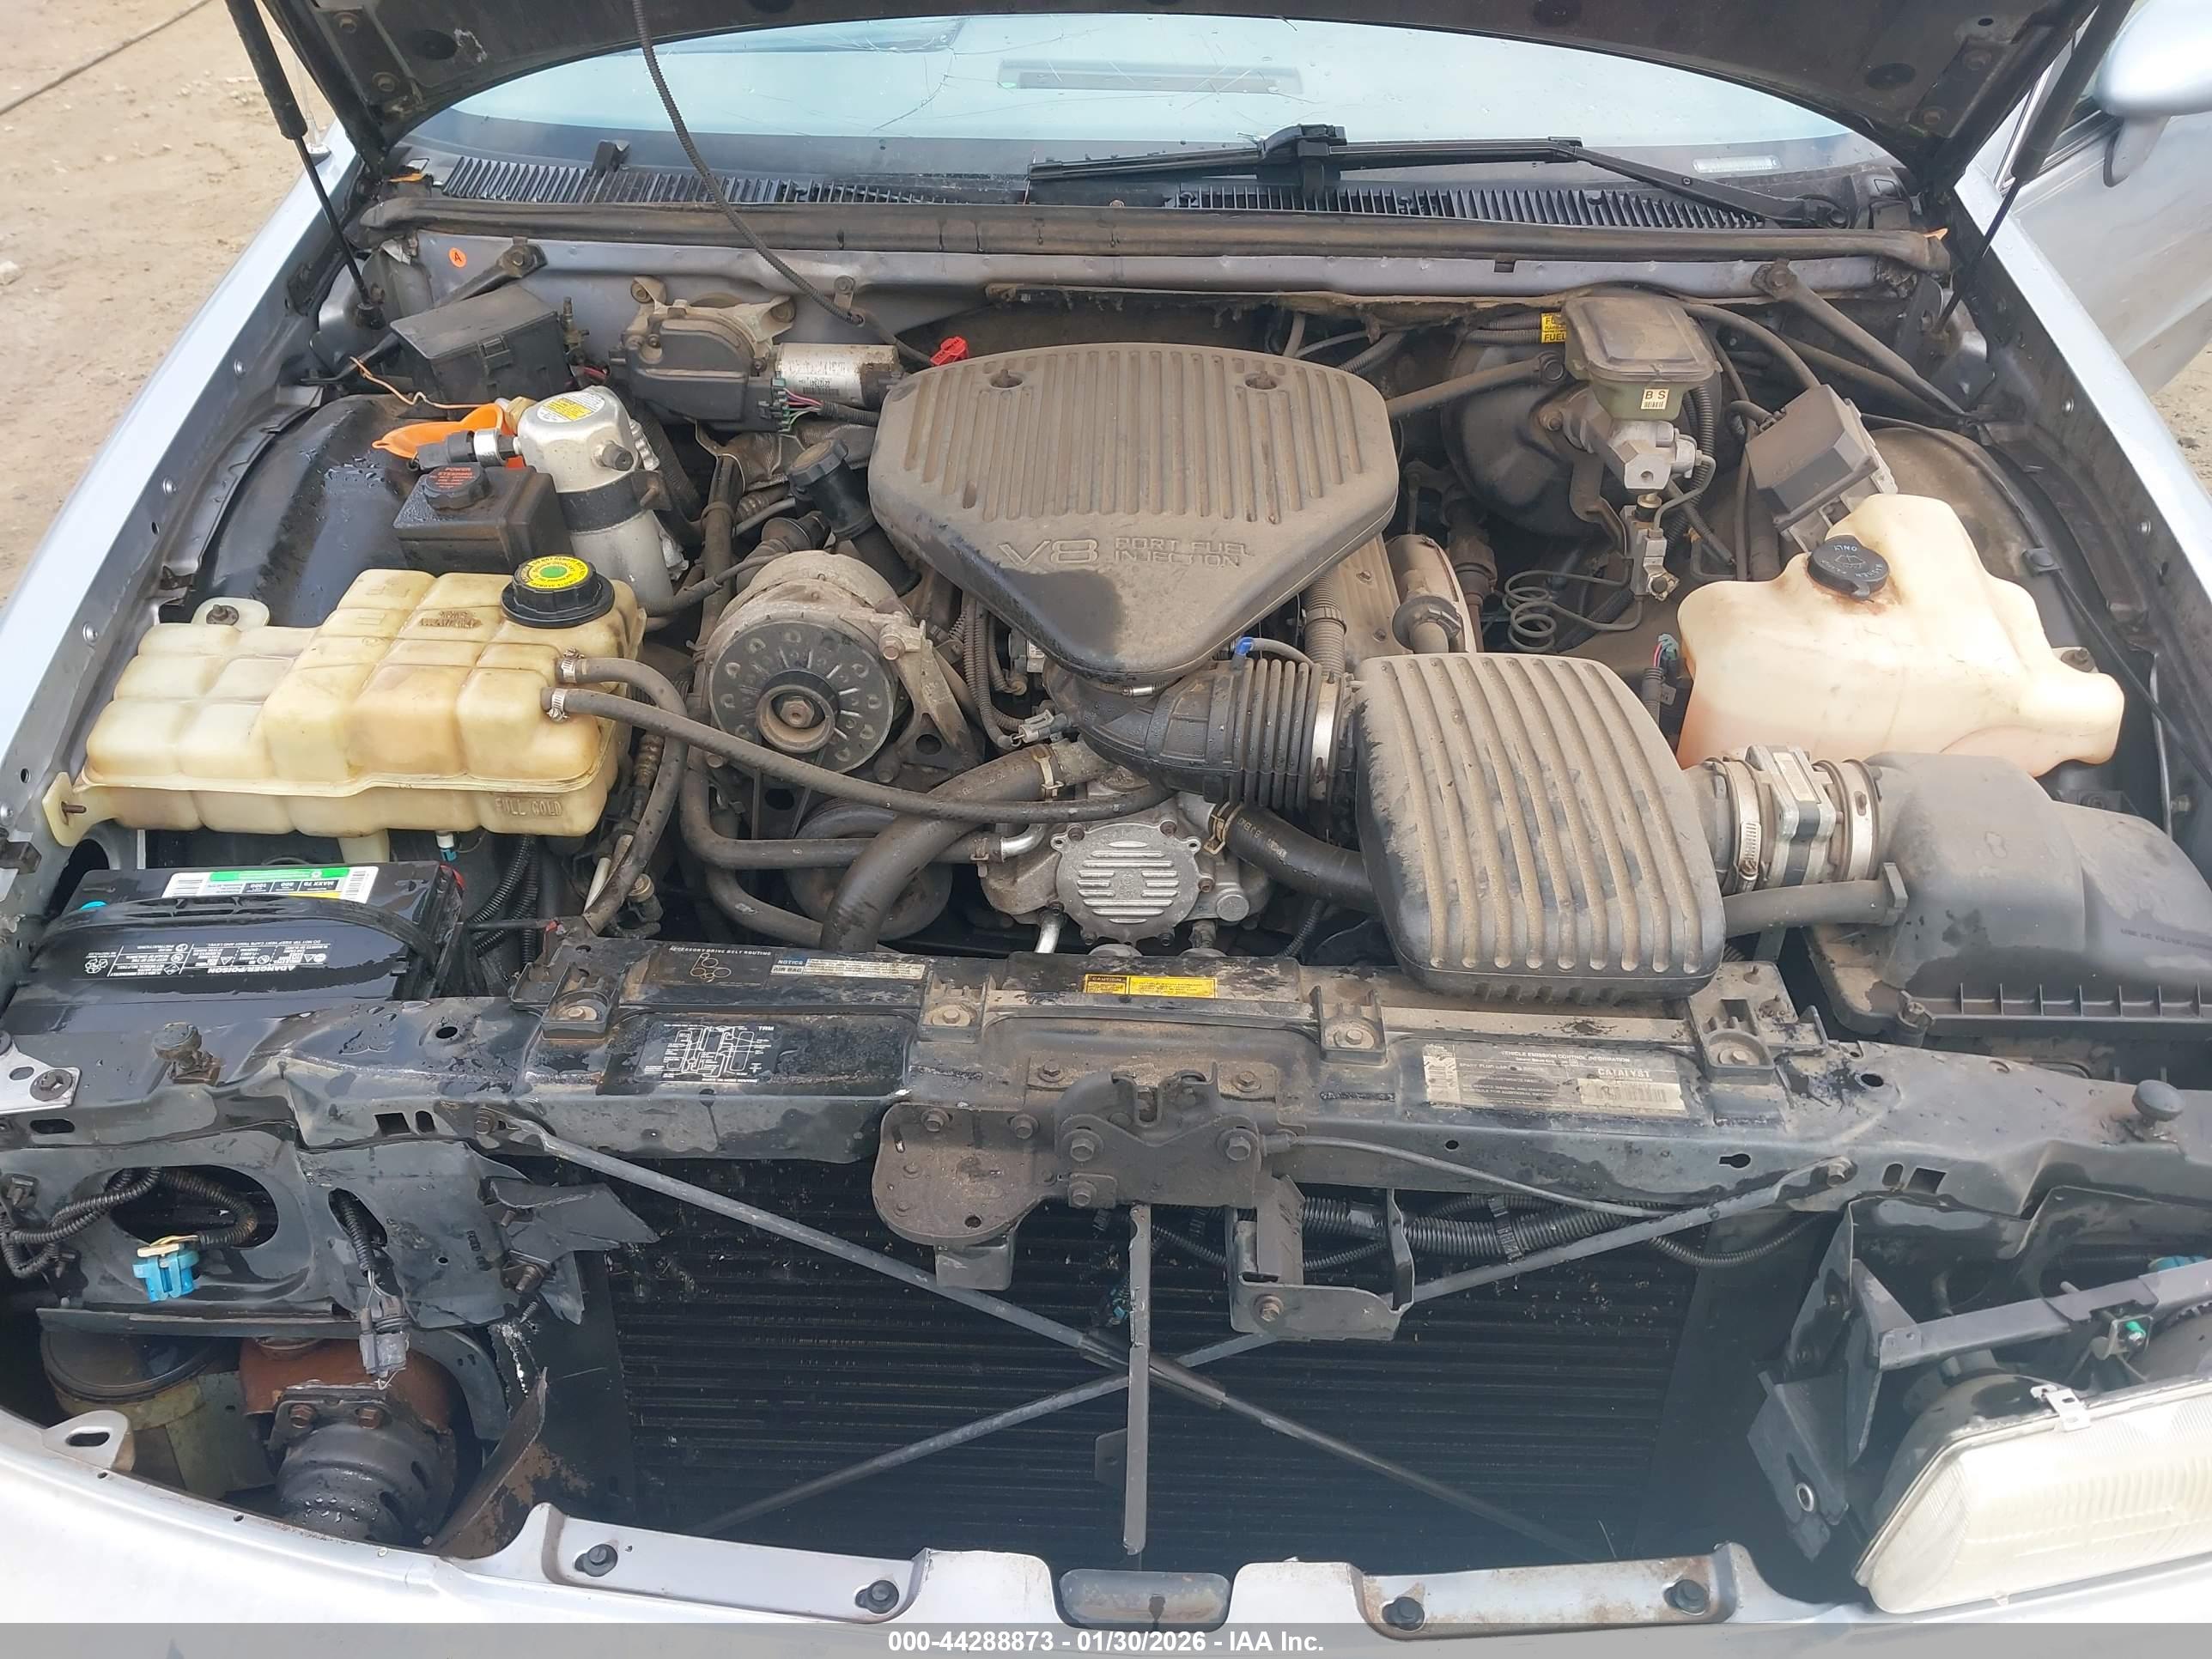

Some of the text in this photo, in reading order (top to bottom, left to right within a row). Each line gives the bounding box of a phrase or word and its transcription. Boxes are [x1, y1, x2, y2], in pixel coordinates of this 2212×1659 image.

[454, 252, 462, 262] A
[1645, 391, 1667, 399] B S
[998, 538, 1099, 568] V8
[1116, 537, 1255, 557] PORT FUEL
[1116, 550, 1240, 567] INJECTION
[495, 798, 562, 816] FULL COLD
[1597, 1067, 1650, 1078] CATALYST
